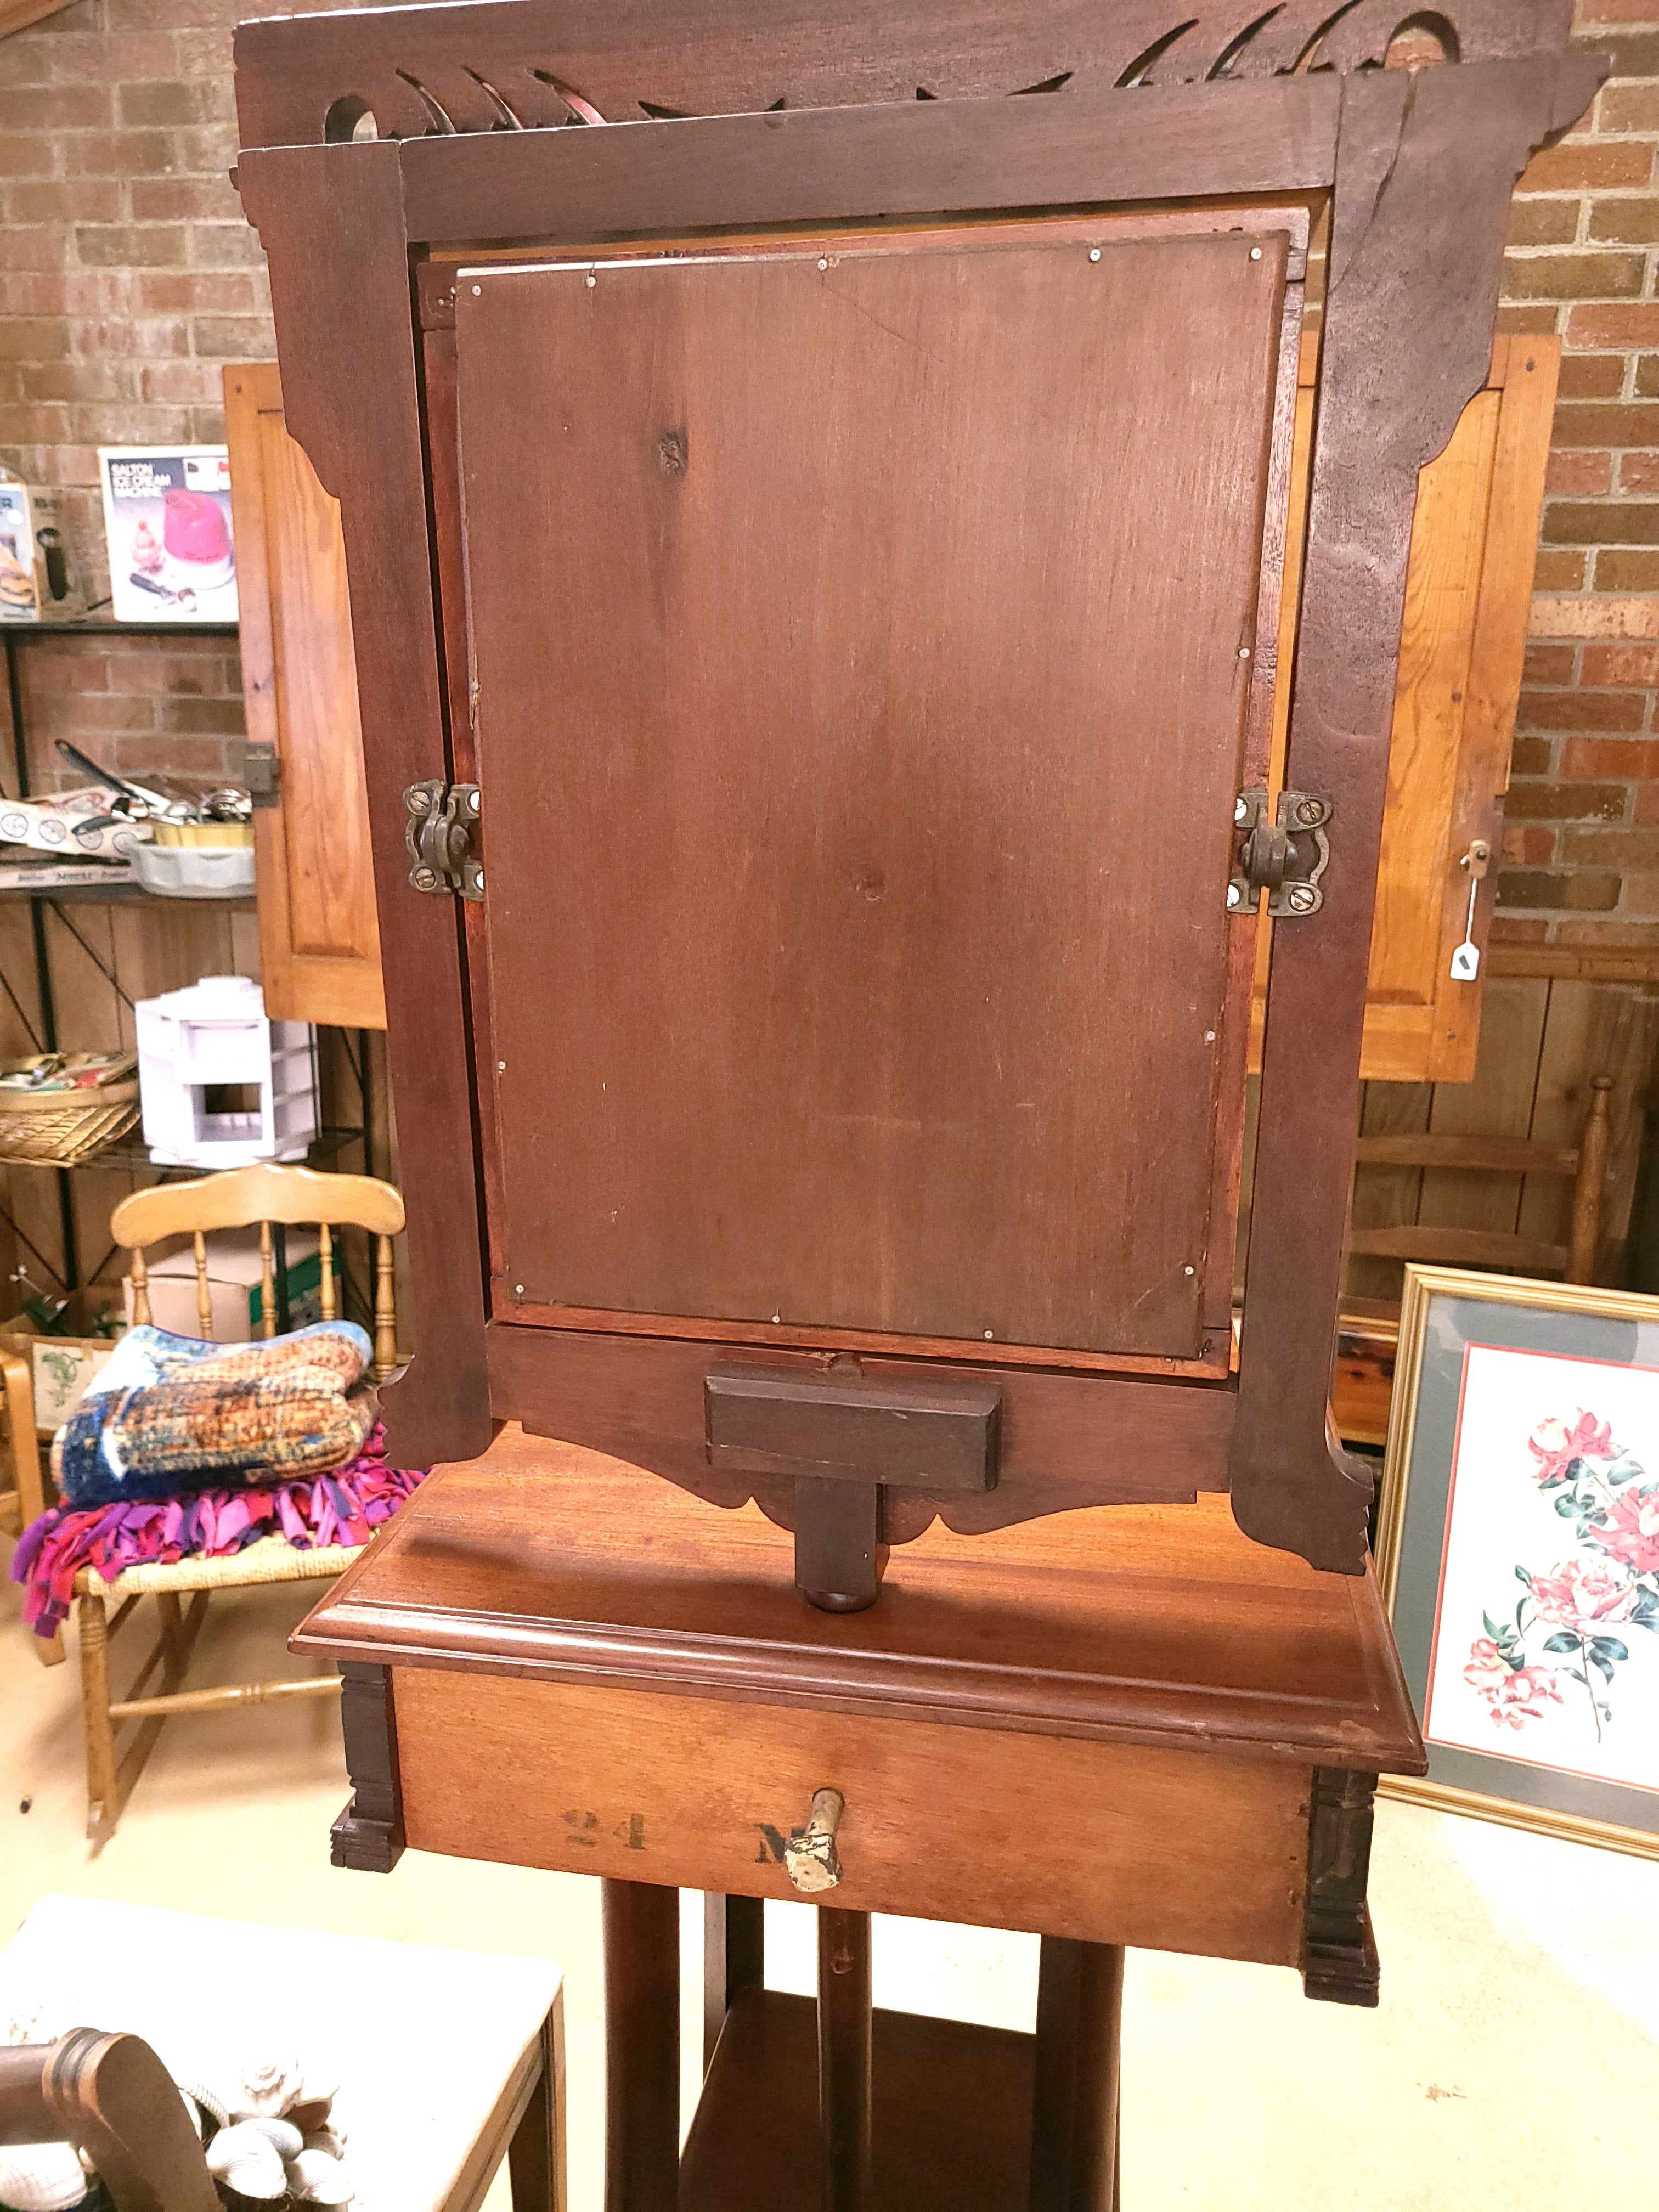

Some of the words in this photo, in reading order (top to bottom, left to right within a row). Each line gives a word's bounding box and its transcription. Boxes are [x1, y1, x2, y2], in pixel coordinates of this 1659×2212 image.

[111, 462, 154, 476] SALTON
[113, 476, 130, 487] ICE
[132, 474, 172, 487] CREAM
